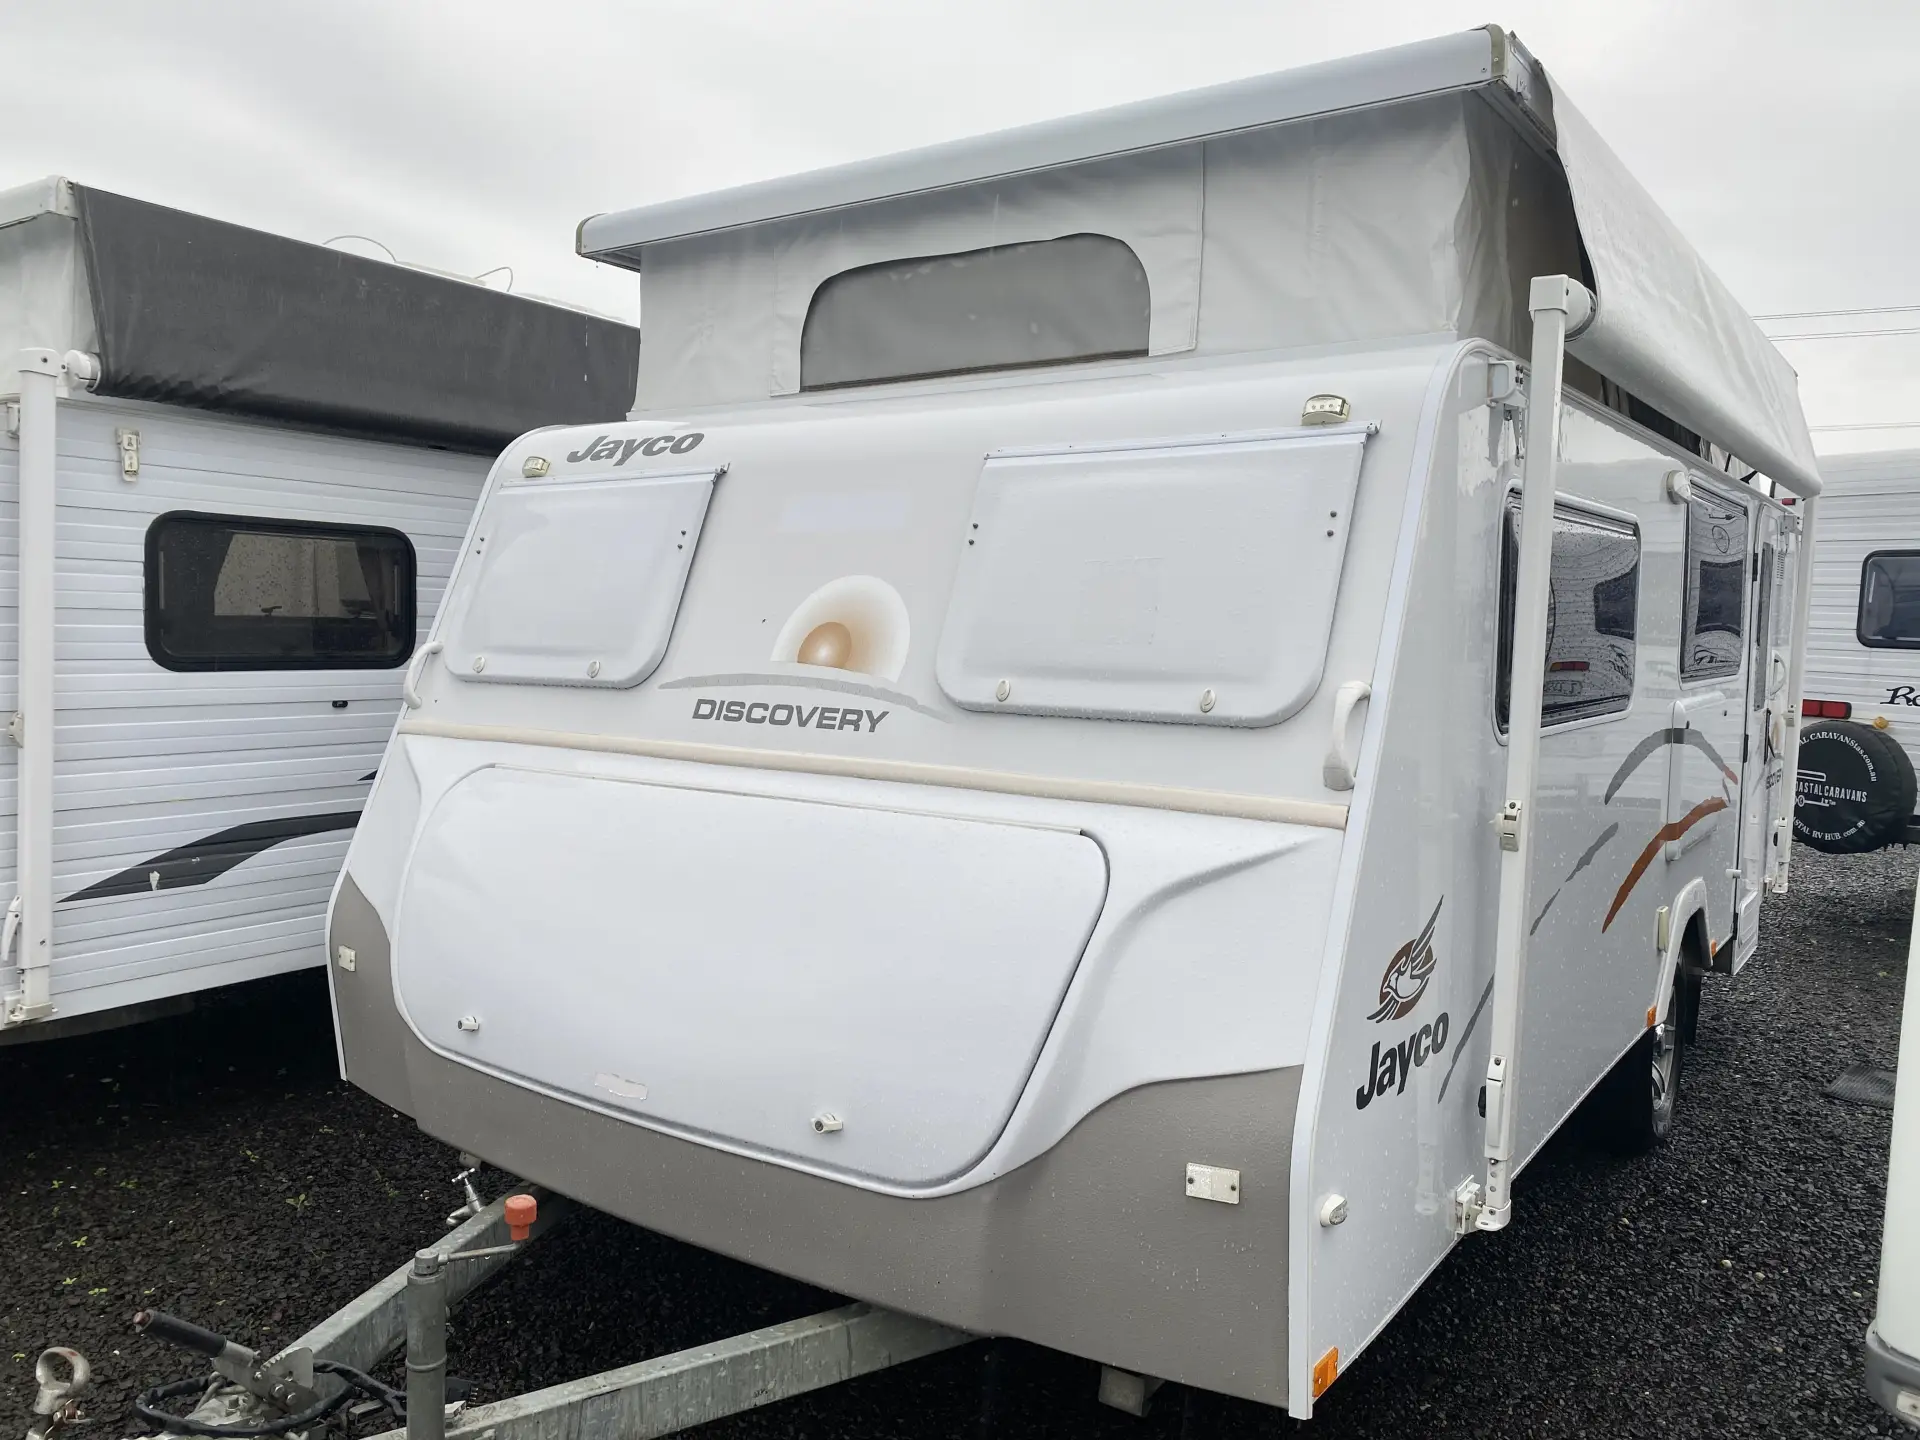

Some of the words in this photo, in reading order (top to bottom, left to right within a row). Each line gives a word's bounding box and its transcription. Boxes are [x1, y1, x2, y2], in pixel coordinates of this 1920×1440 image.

[566, 433, 705, 466] Jayco
[692, 699, 889, 732] DISCOVERY
[1824, 785, 1867, 803] CARAVANS
[1812, 830, 1823, 839] RV
[1356, 1012, 1449, 1110] Jayco
